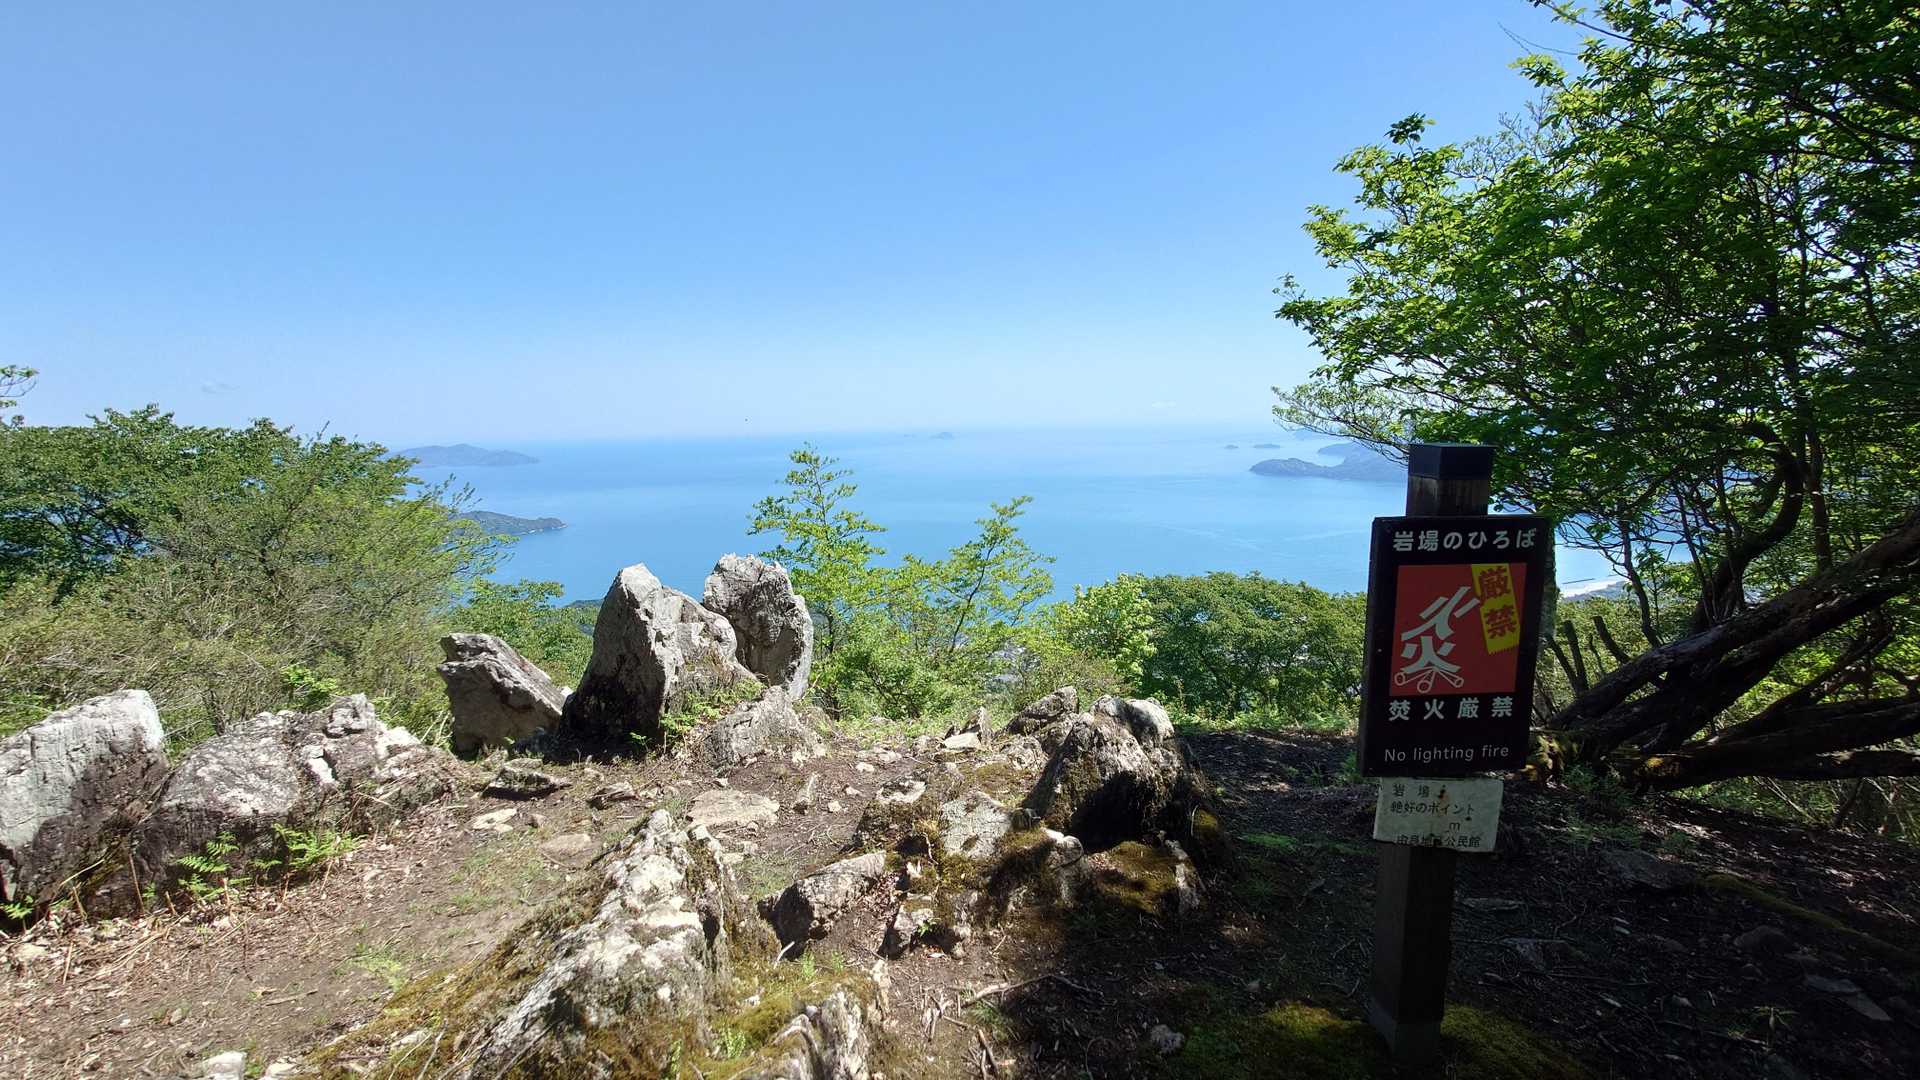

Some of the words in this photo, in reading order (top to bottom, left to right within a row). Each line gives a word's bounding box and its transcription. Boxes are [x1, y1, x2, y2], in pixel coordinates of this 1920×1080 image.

[1393, 528, 1537, 552] 岩場のひろば
[1477, 565, 1517, 639] 厳禁
[1388, 696, 1513, 721] 焚火厳禁
[1384, 748, 1406, 763] No
[1413, 746, 1474, 764] lighting
[1481, 744, 1509, 758] fire
